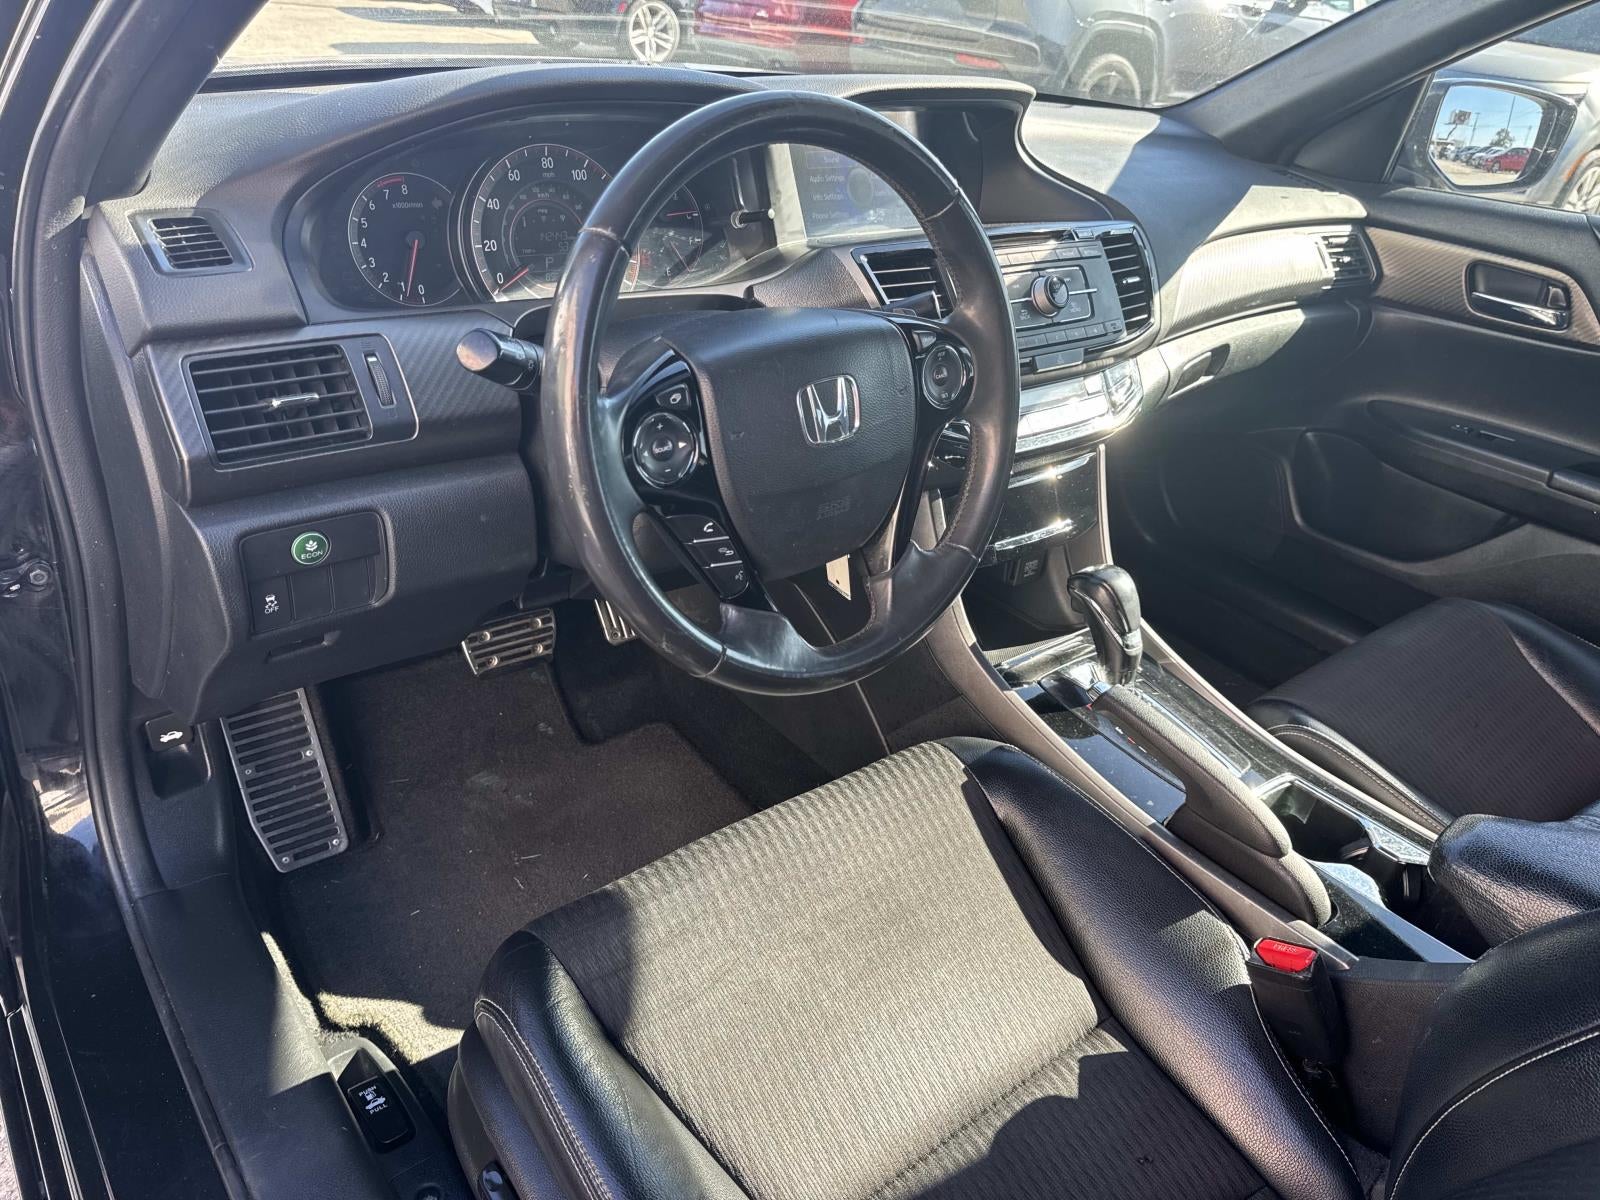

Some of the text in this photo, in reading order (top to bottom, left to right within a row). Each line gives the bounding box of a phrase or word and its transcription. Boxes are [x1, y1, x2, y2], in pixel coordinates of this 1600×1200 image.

[541, 157, 554, 169] 80
[507, 169, 521, 182] 60
[571, 169, 588, 182] 100
[383, 189, 390, 200] 7
[401, 184, 409, 195] 8
[369, 201, 376, 211] 6
[486, 198, 500, 211] 40
[360, 217, 368, 229] 5
[360, 237, 367, 249] 4
[484, 239, 498, 252] 20
[368, 257, 376, 268] 3
[382, 271, 390, 283] 2
[496, 272, 504, 285] 0
[400, 281, 406, 292] 1
[418, 284, 425, 295] 0
[300, 550, 323, 560] ECON
[264, 605, 279, 615] OFF
[358, 1085, 377, 1096] PUSH
[369, 1104, 389, 1115] PULL
